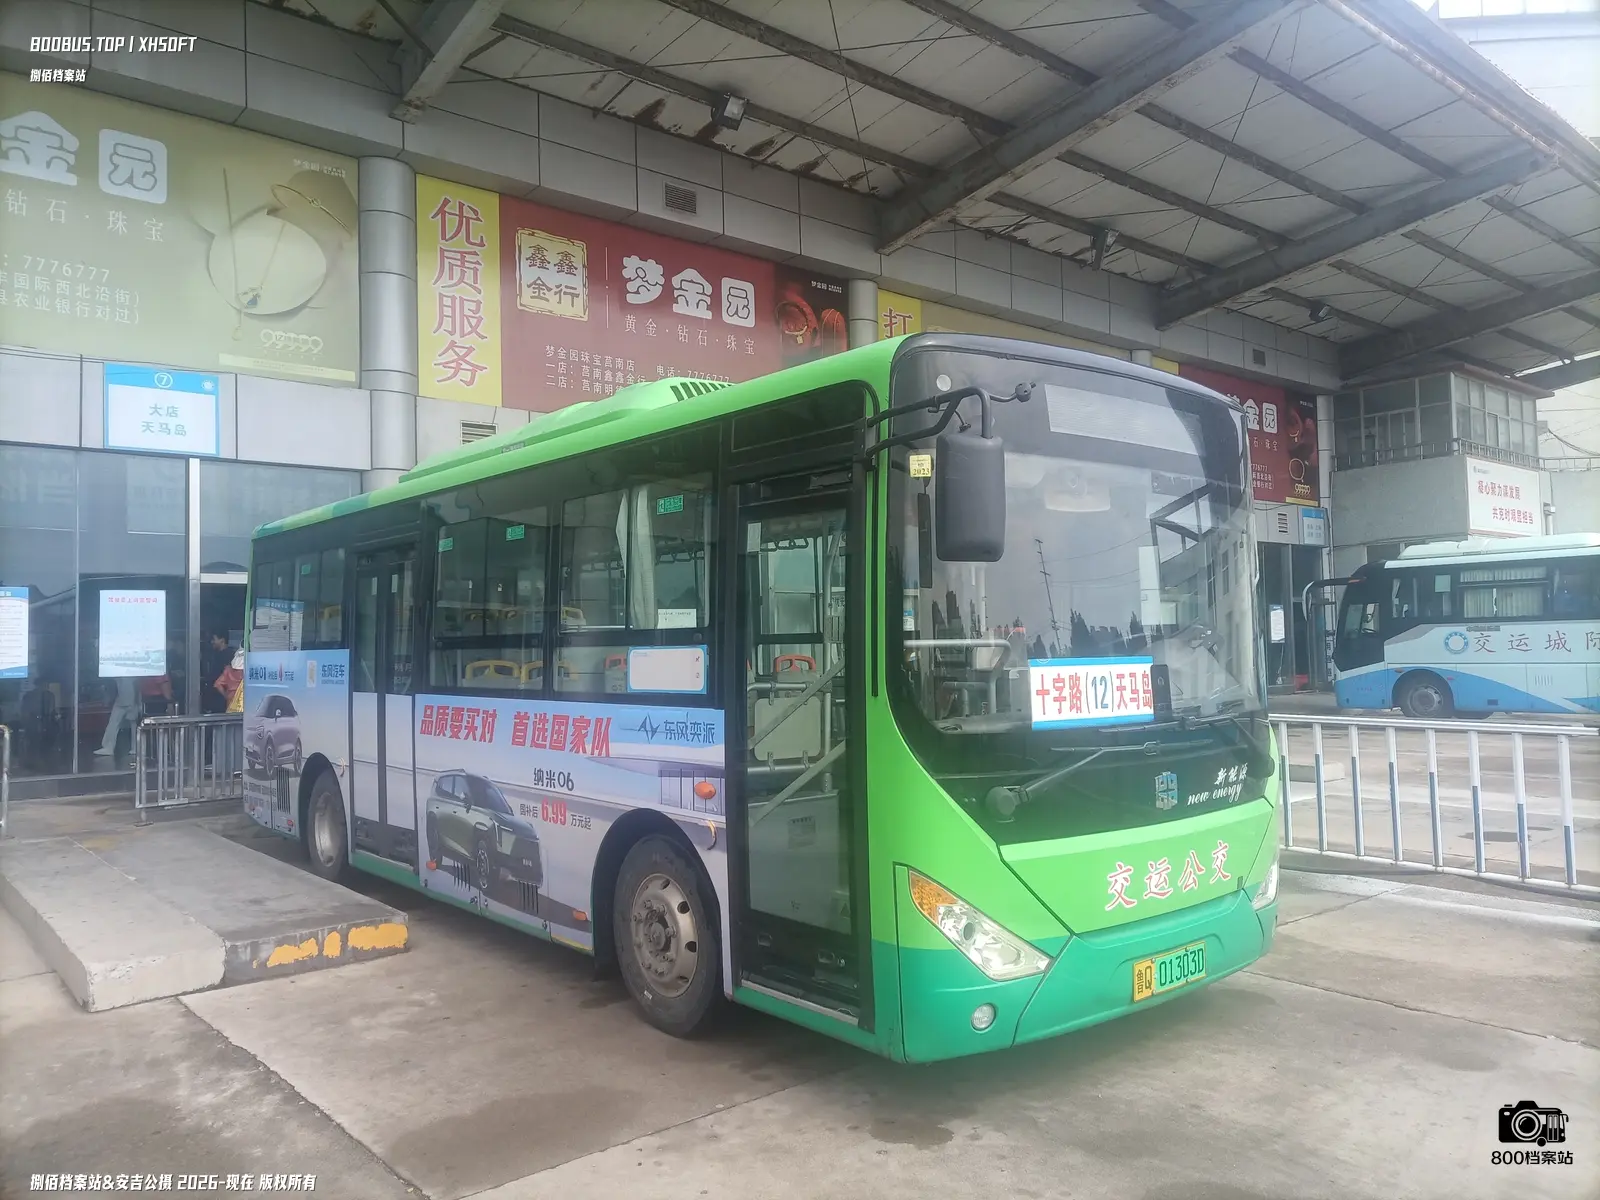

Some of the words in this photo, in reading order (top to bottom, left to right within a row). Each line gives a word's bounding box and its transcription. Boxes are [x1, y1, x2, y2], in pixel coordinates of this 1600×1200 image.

[430, 196, 488, 387] 优质服务
[622, 254, 756, 328] 梦金园
[545, 344, 636, 372] 梦金园珠宝莒南店
[148, 403, 180, 418] 大店
[141, 421, 187, 437] 天马岛
[420, 704, 497, 744] 品质要买对
[511, 711, 613, 757] 首选国家队
[663, 718, 716, 745] 东风奕派
[533, 767, 575, 792] 纳米06
[1187, 791, 1210, 806] new
[1212, 782, 1243, 803] energy
[541, 796, 568, 826] 6.99
[570, 813, 592, 831] 万元起
[1104, 839, 1232, 912] 交运公交
